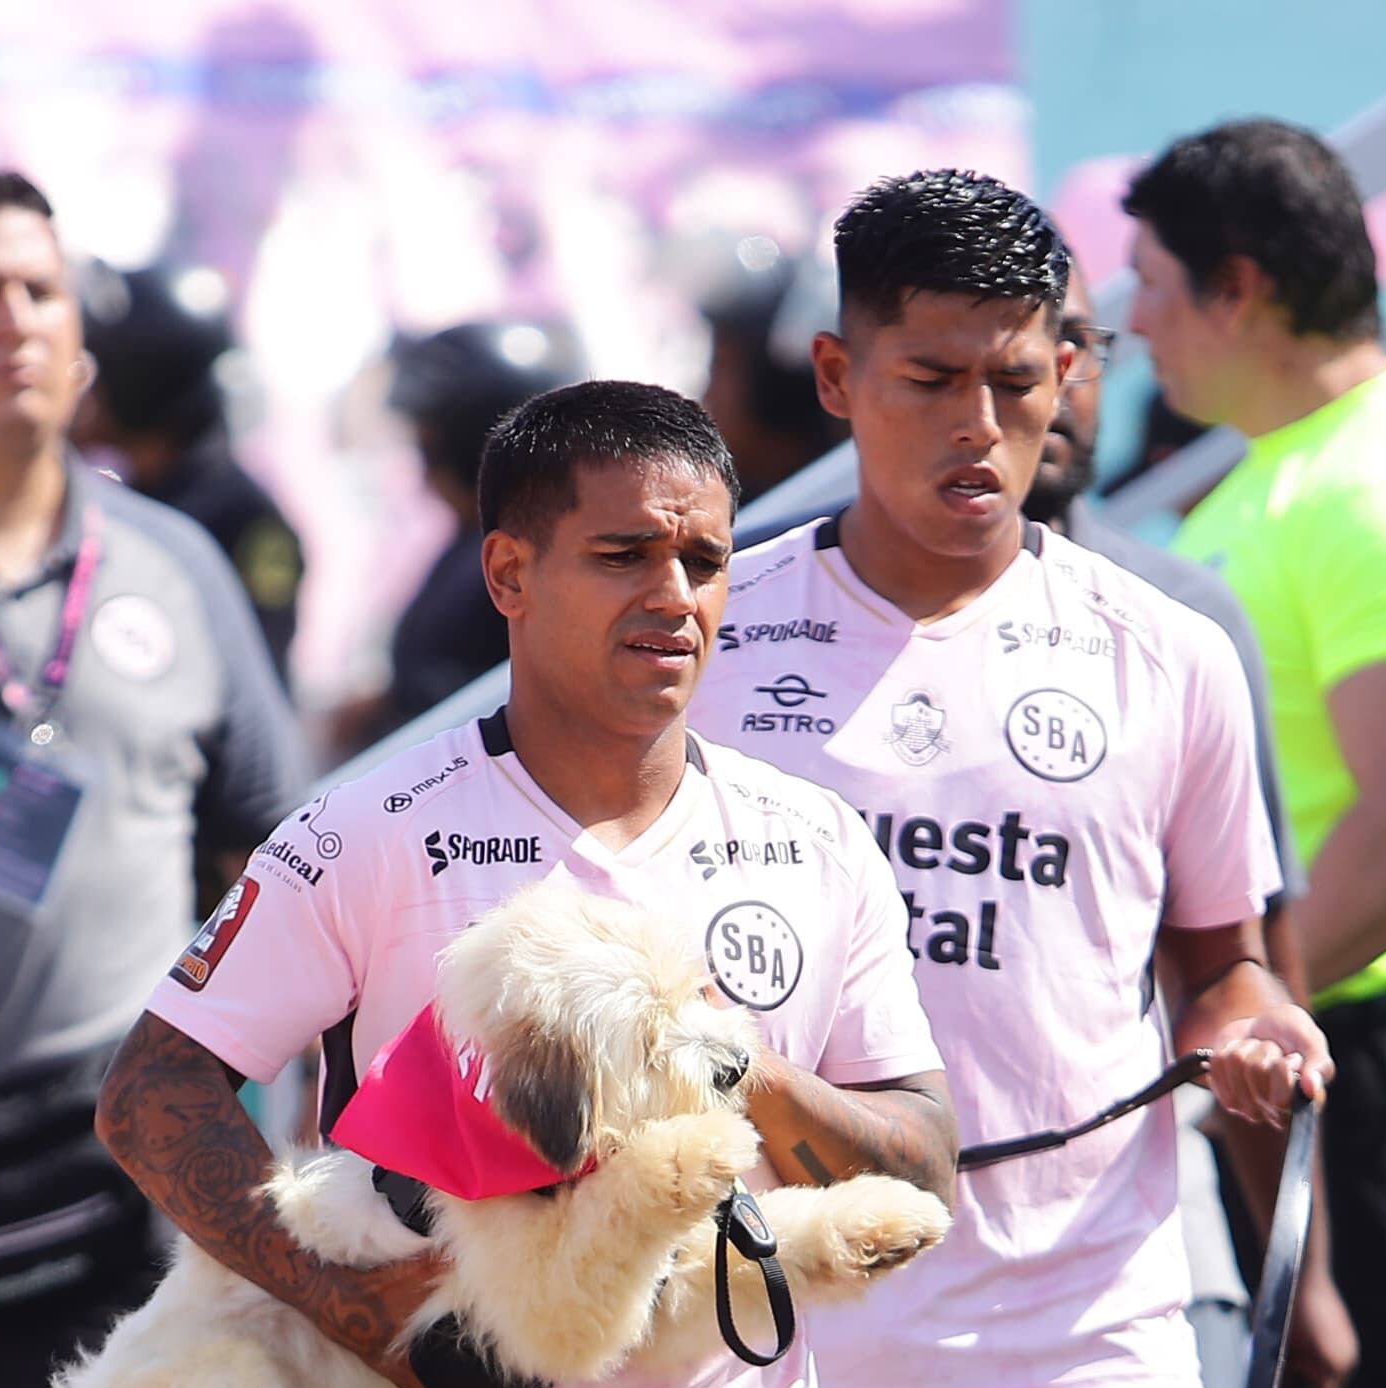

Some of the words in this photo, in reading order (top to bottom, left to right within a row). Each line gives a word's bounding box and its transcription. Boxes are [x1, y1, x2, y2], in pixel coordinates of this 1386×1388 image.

[743, 618, 838, 644] SPORADE
[741, 713, 835, 735] ASTRO
[1023, 704, 1088, 764] SBA
[412, 756, 469, 796] MAXUS
[447, 833, 543, 866] SPORADE
[714, 839, 804, 866] SPORADE
[901, 890, 1001, 970] tal
[720, 921, 786, 990] SBA
